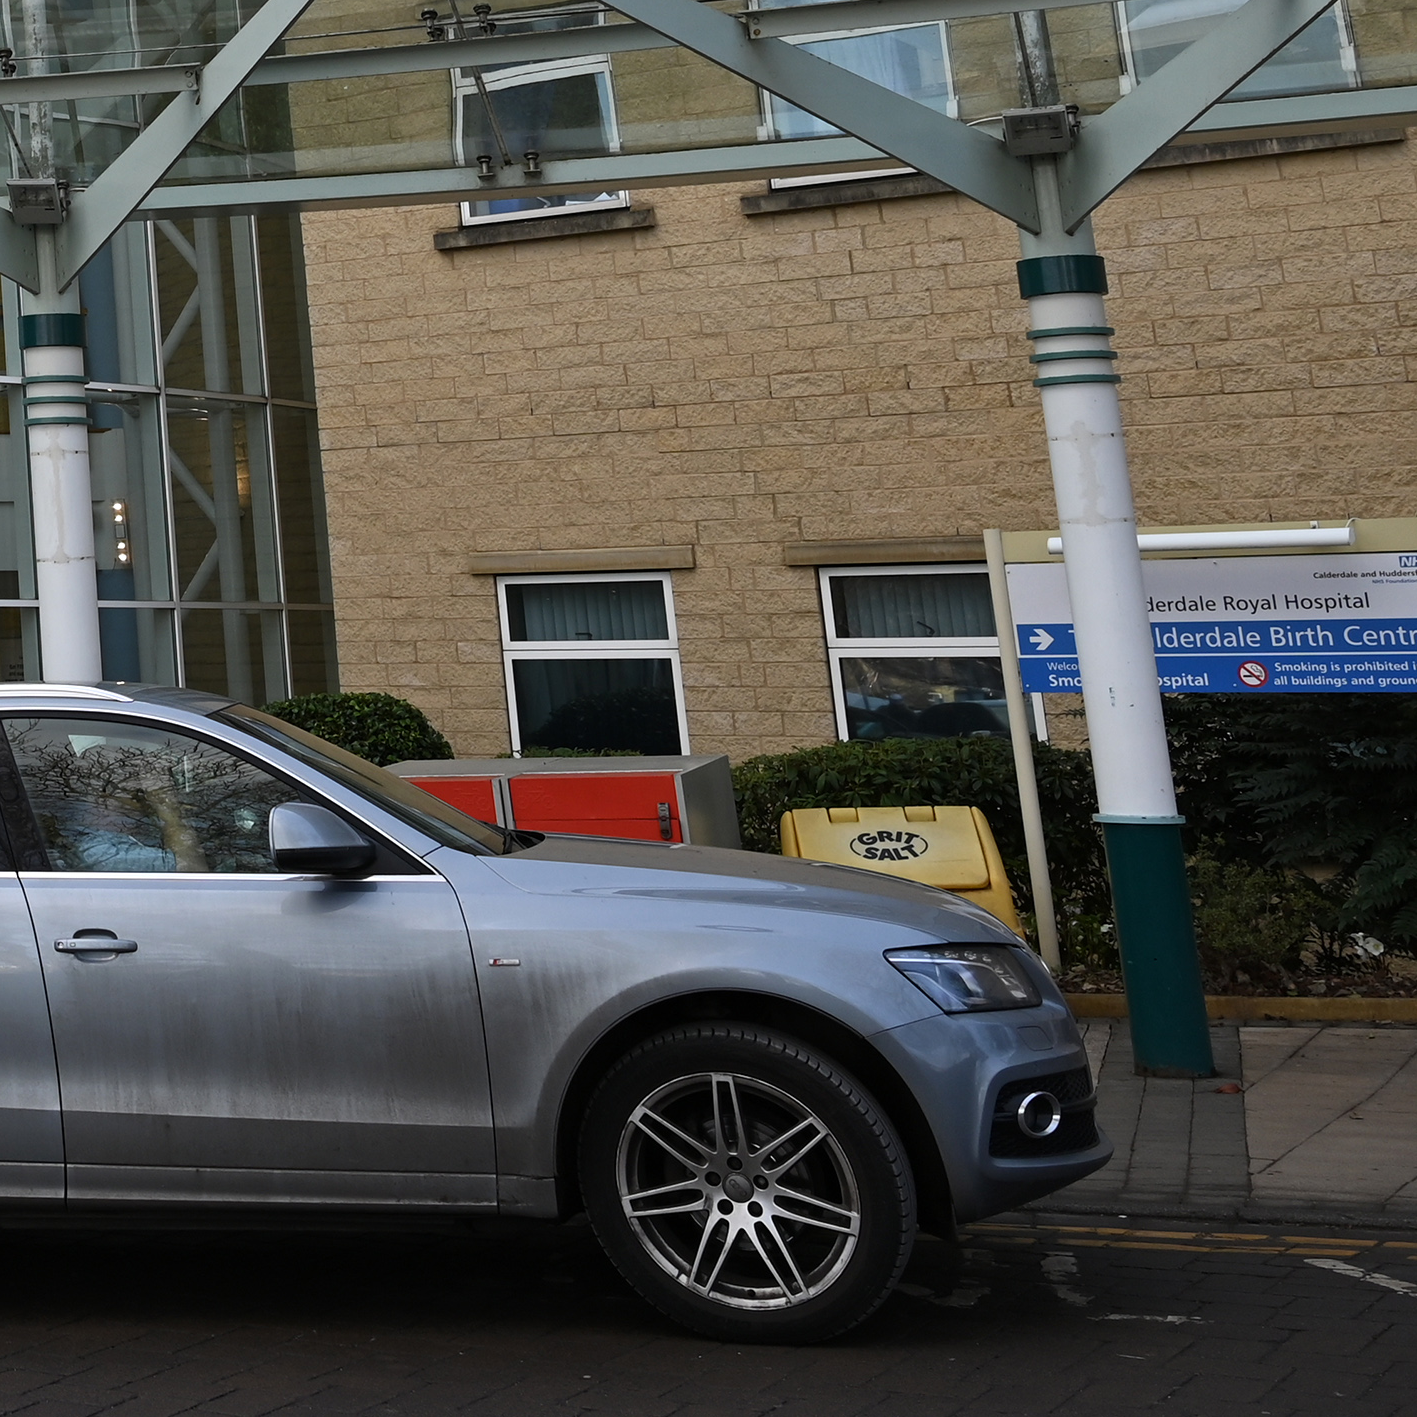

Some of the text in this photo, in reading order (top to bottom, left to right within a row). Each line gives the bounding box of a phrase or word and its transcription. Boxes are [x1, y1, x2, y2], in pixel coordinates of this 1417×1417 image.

[1313, 571, 1358, 579] Calderdale
[1147, 592, 1370, 614] derdale Royal Hospital
[1155, 625, 1261, 648] lderdale
[1269, 625, 1334, 647] Birth
[1046, 662, 1078, 670] Welco
[1274, 661, 1409, 673] Smoking is prohibited
[1049, 674, 1082, 687] Smo
[1274, 675, 1417, 688] all buildings and groun
[857, 830, 920, 845] GRIT
[862, 844, 920, 861] SALT
